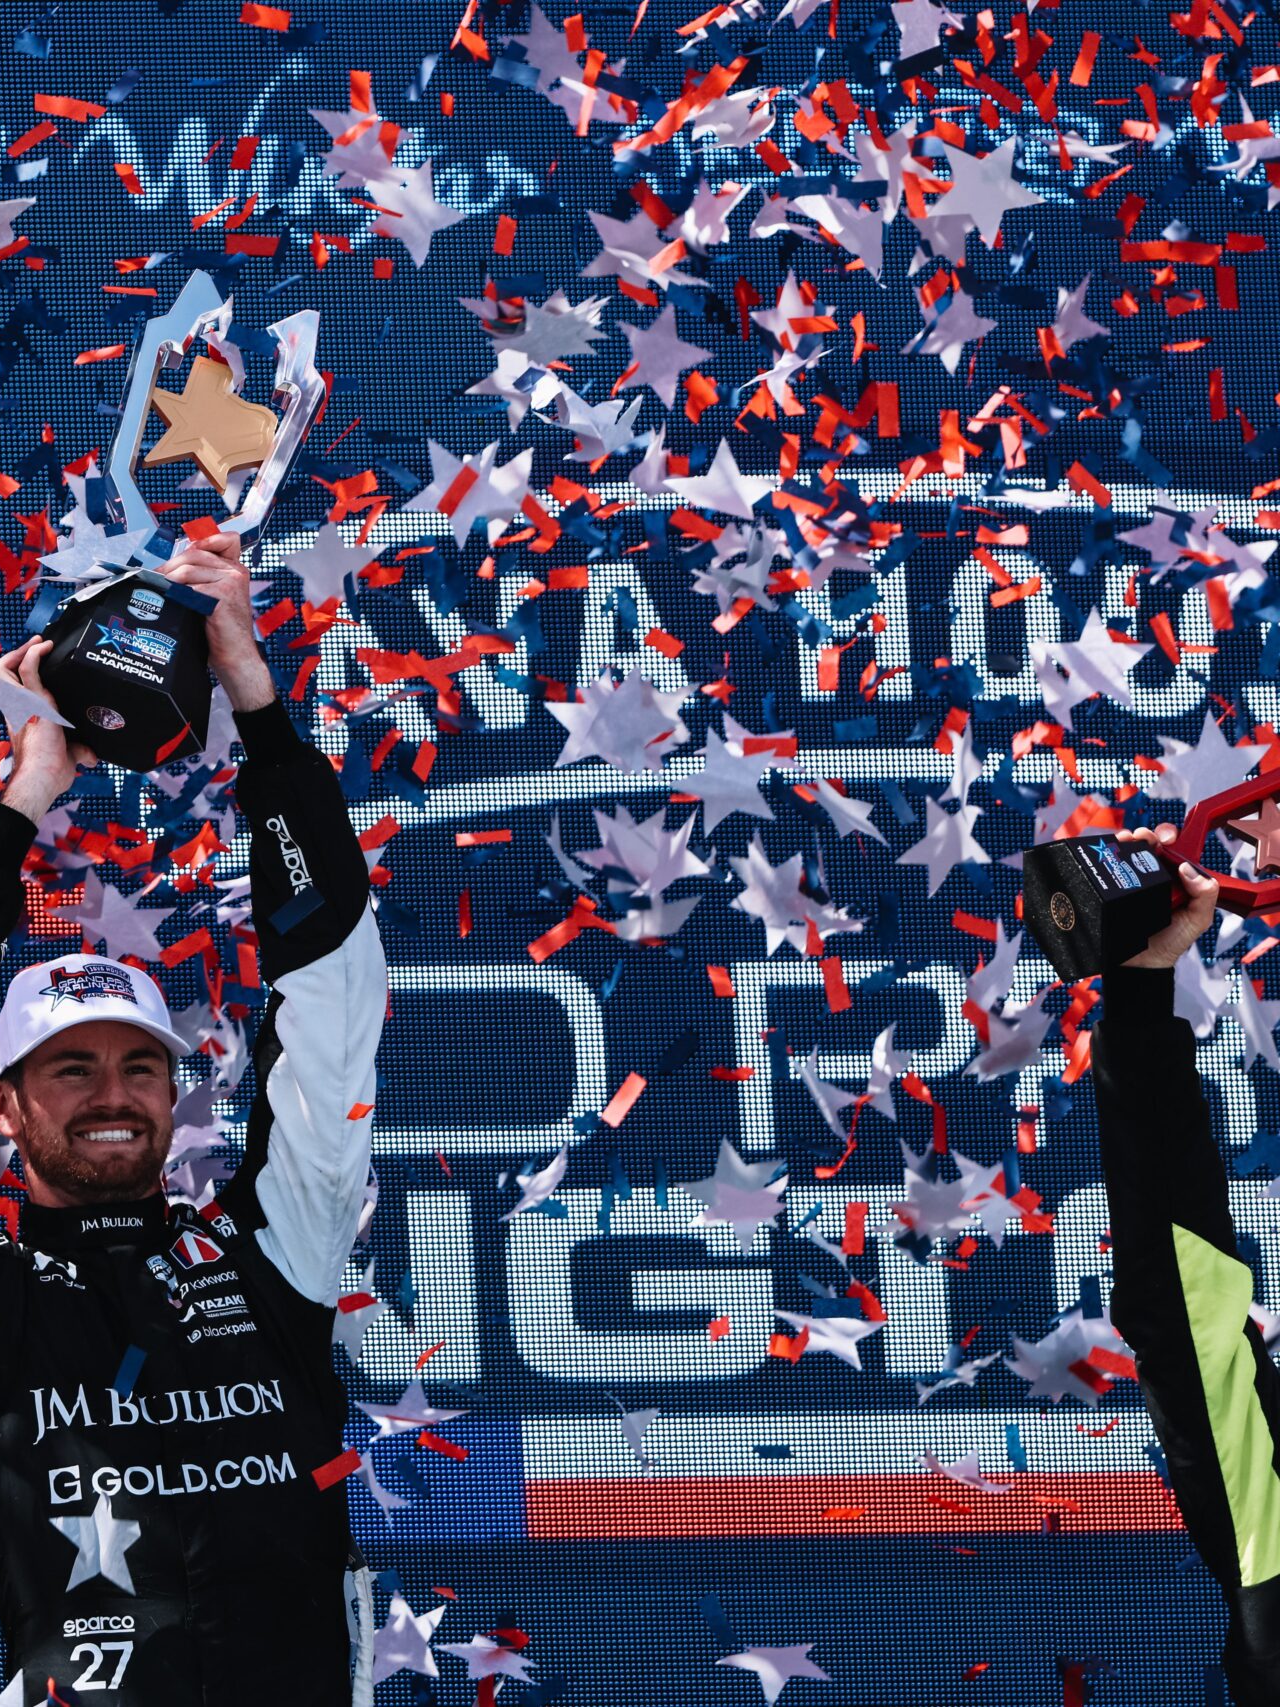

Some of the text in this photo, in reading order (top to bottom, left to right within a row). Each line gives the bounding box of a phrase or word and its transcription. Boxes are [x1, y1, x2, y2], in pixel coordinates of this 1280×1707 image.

[129, 598, 162, 612] INDYCAR
[111, 629, 174, 653] GRAND PRIX
[112, 635, 172, 659] ARLINGTON
[314, 548, 1280, 758] AVA HOU
[86, 651, 164, 684] CHAMPION
[100, 649, 156, 673] INAUGURAL
[1076, 845, 1109, 890] THIRD PLACE
[58, 975, 132, 989] GRAND PRIX
[63, 983, 134, 995] ARLINGTON
[81, 1216, 144, 1233] JM BULLION
[194, 1294, 246, 1311] YAZAKI
[202, 1321, 257, 1337] blackpoint
[30, 1380, 285, 1445] JM BULLION
[92, 1452, 298, 1497] GOLD.COM
[63, 1615, 136, 1637] sparco
[70, 1640, 134, 1691] 27
